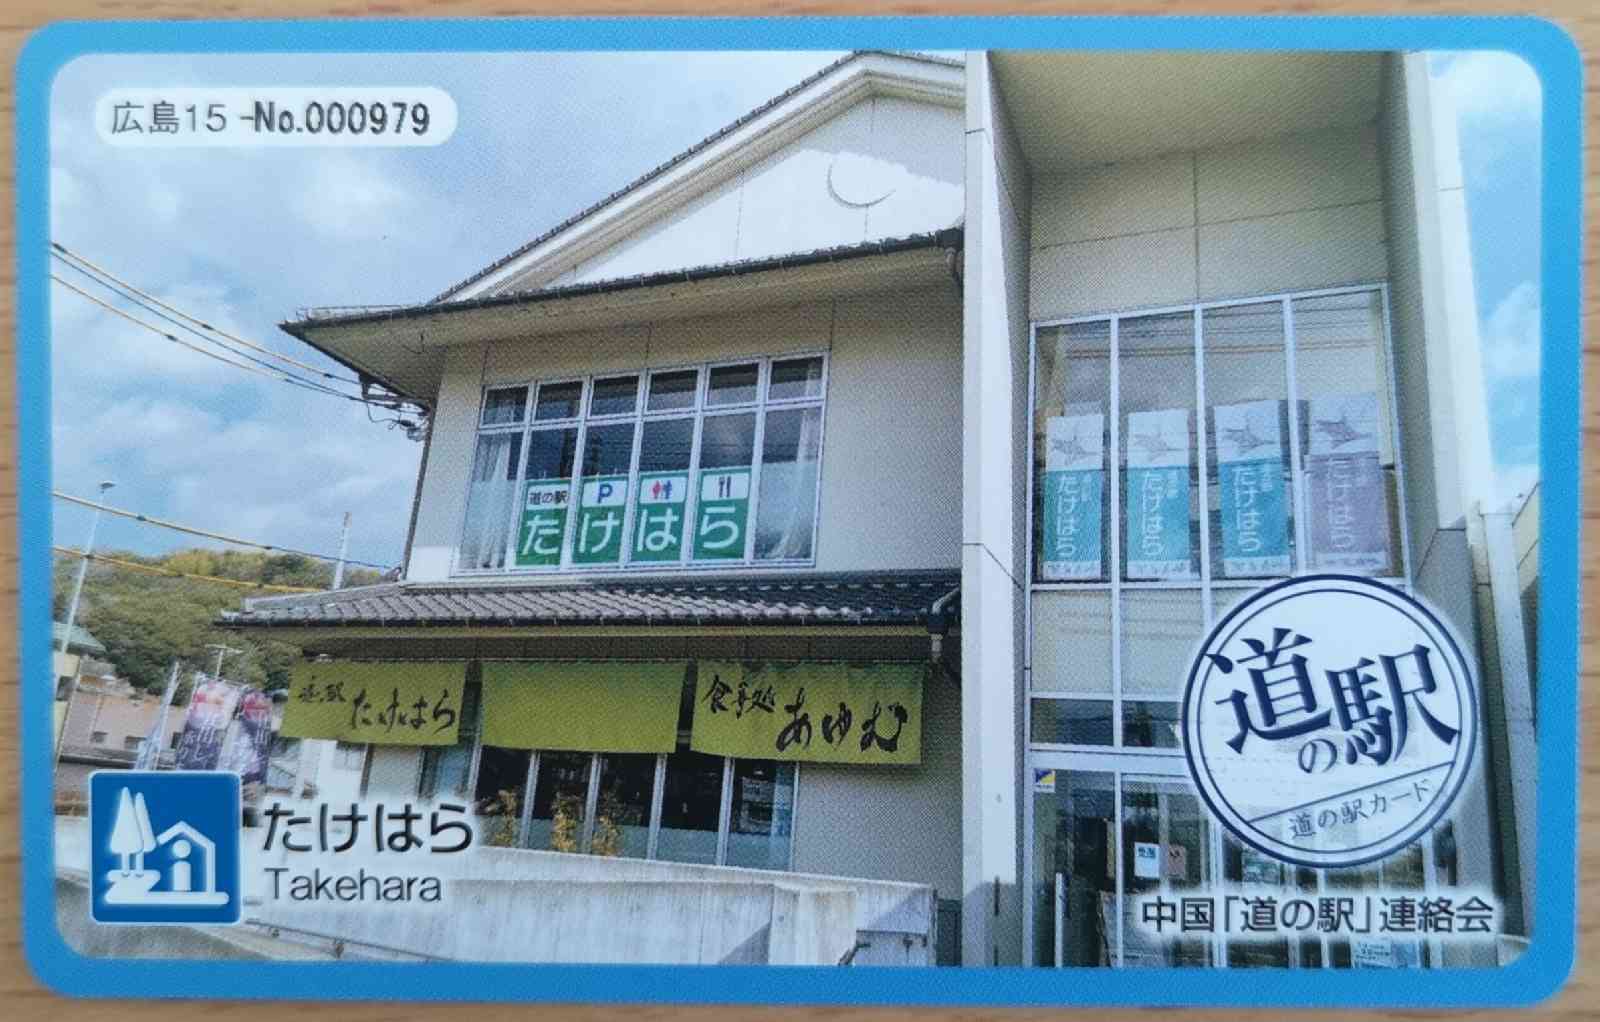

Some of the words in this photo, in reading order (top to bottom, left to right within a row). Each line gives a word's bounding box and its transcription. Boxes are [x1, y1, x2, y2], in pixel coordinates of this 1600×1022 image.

[111, 101, 227, 134] 広島15
[529, 489, 569, 504] 道の駅
[598, 484, 613, 503] P
[1055, 474, 1080, 557] たけはら
[1140, 470, 1166, 556] たけはら
[1232, 464, 1263, 552] たけはら
[522, 507, 739, 555] たけはら
[351, 688, 456, 735] たけはら
[775, 687, 908, 751] あゆむ
[1204, 628, 1461, 774] 道の駅
[262, 802, 474, 854] たけはら
[1289, 779, 1429, 839] 道の駅カード
[264, 867, 443, 902] Takehara
[1141, 896, 1494, 934] 中国「道の駅」連絡会
